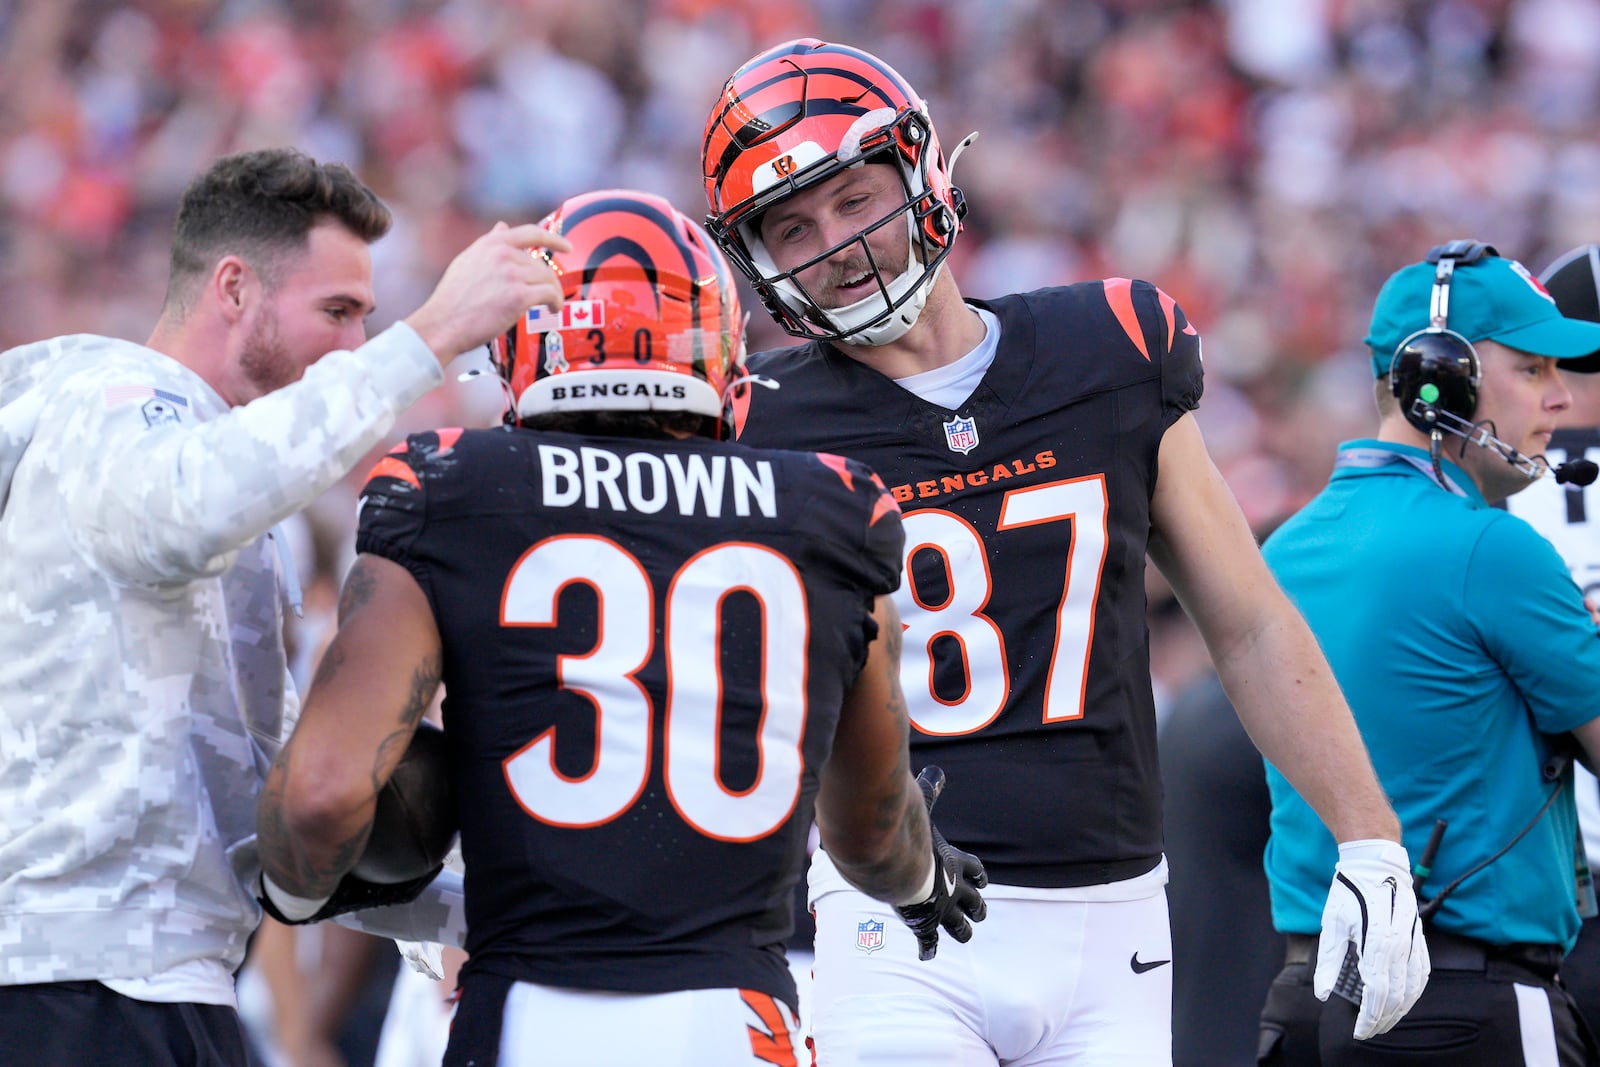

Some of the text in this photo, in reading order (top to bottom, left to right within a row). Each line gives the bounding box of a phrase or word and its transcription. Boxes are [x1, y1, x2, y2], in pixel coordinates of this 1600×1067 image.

[552, 384, 686, 400] BENGALS
[951, 432, 974, 448] NFL
[537, 444, 778, 518] BROWN
[891, 450, 1057, 503] BENGALS
[901, 473, 1109, 736] 87
[499, 533, 809, 842] 30
[860, 933, 880, 946] NFL
